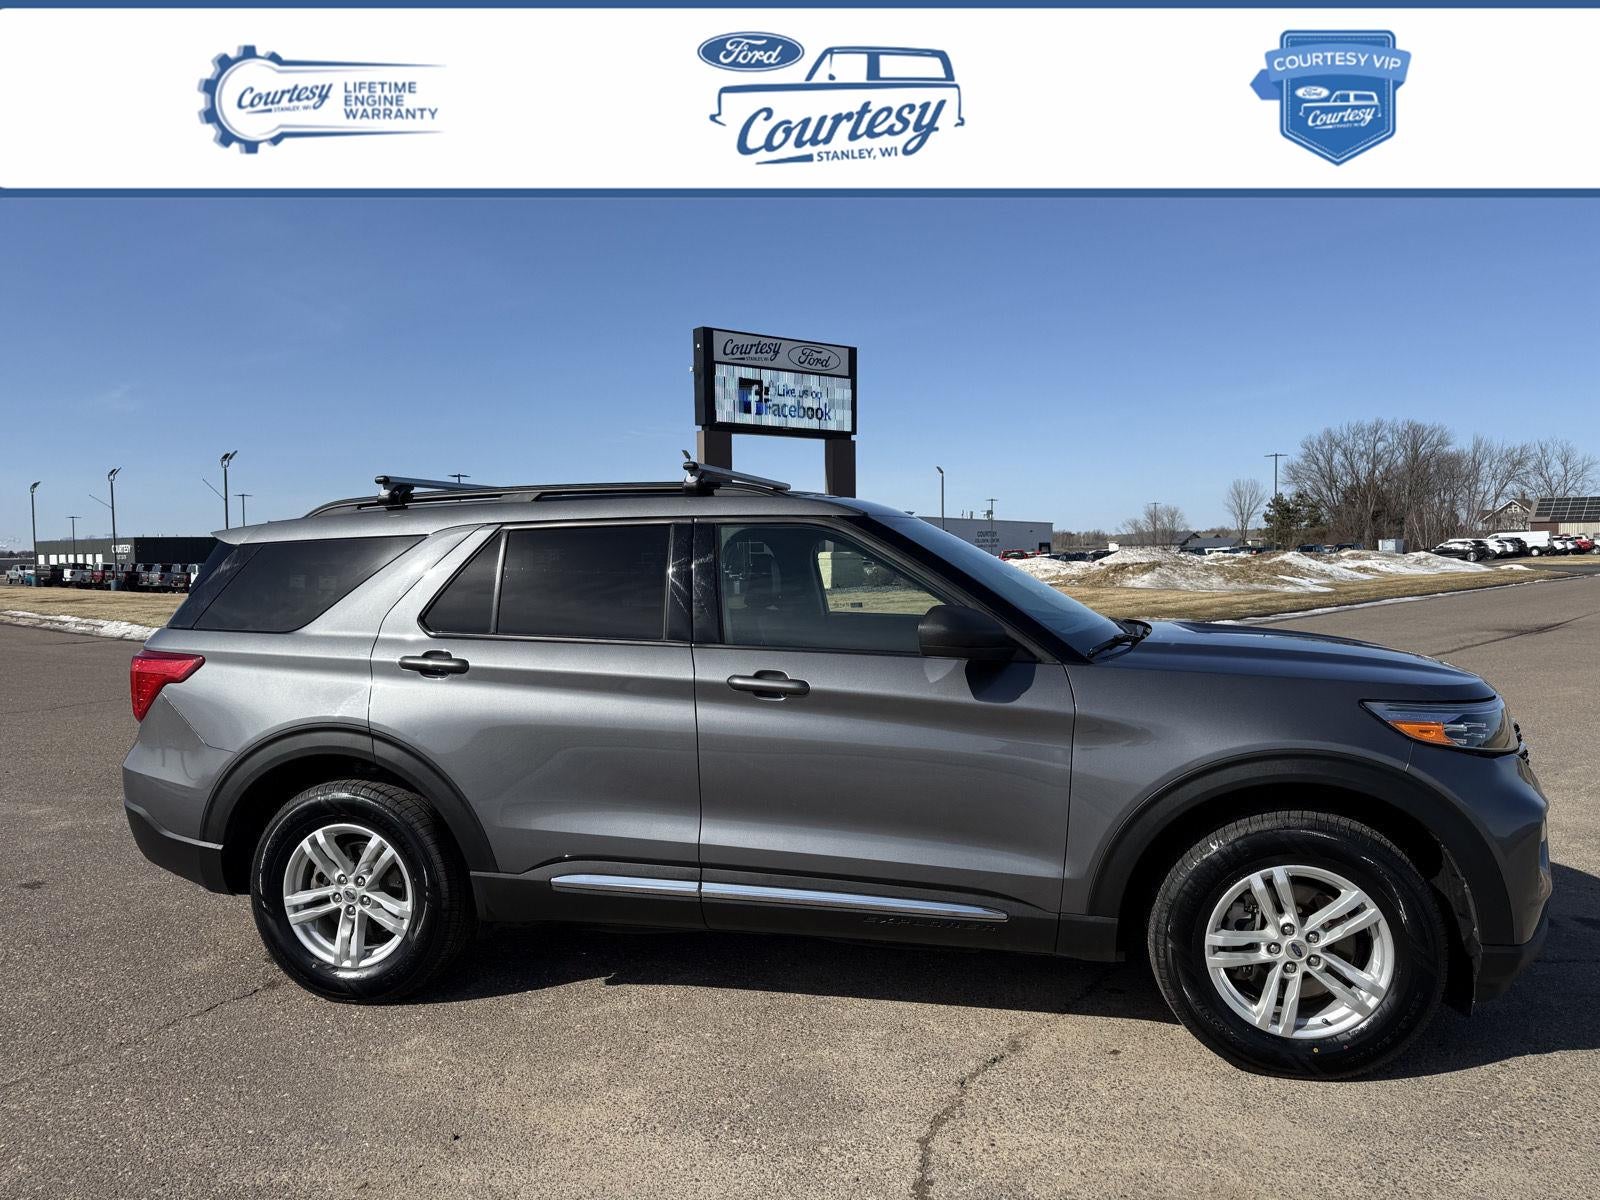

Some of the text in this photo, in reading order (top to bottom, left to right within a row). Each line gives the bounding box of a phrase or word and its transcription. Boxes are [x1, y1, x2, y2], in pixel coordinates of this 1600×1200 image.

[723, 338, 782, 362] Courtesy
[798, 347, 831, 368] Ford
[777, 384, 796, 398] Like
[798, 389, 809, 398] us
